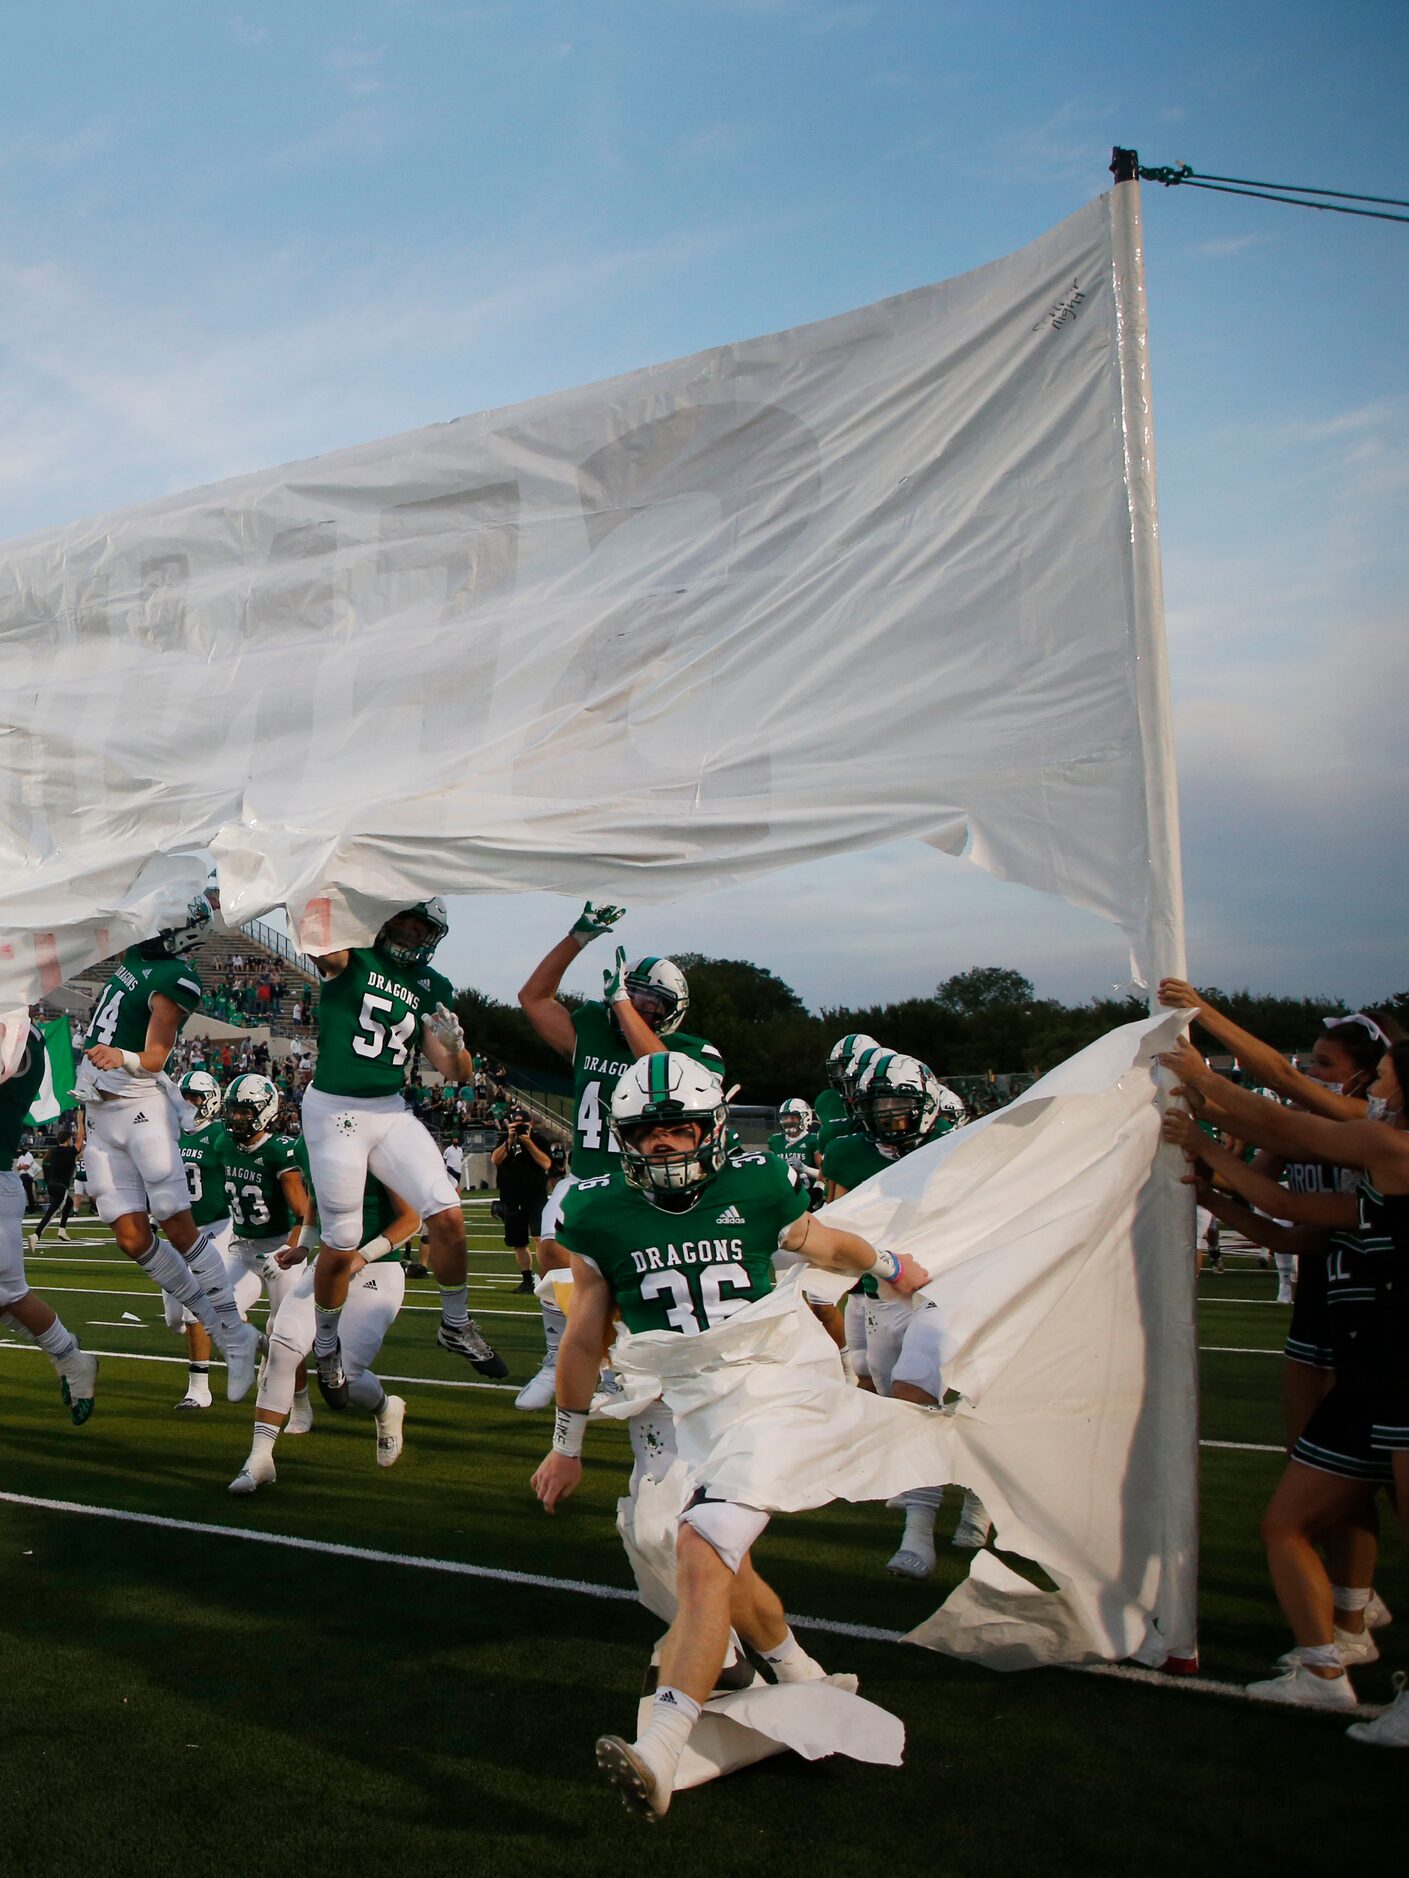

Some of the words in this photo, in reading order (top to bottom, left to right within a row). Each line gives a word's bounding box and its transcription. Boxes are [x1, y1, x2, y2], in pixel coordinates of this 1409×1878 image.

[367, 971, 420, 1010] DRAGONS
[86, 983, 126, 1046] 14
[352, 992, 416, 1066] 54
[583, 1055, 630, 1077] DRAGO
[180, 1148, 204, 1159] GONS
[224, 1181, 272, 1226] 33
[715, 1216, 746, 1225] adidas
[630, 1238, 743, 1274] DRAGONS
[640, 1262, 752, 1335] 36
